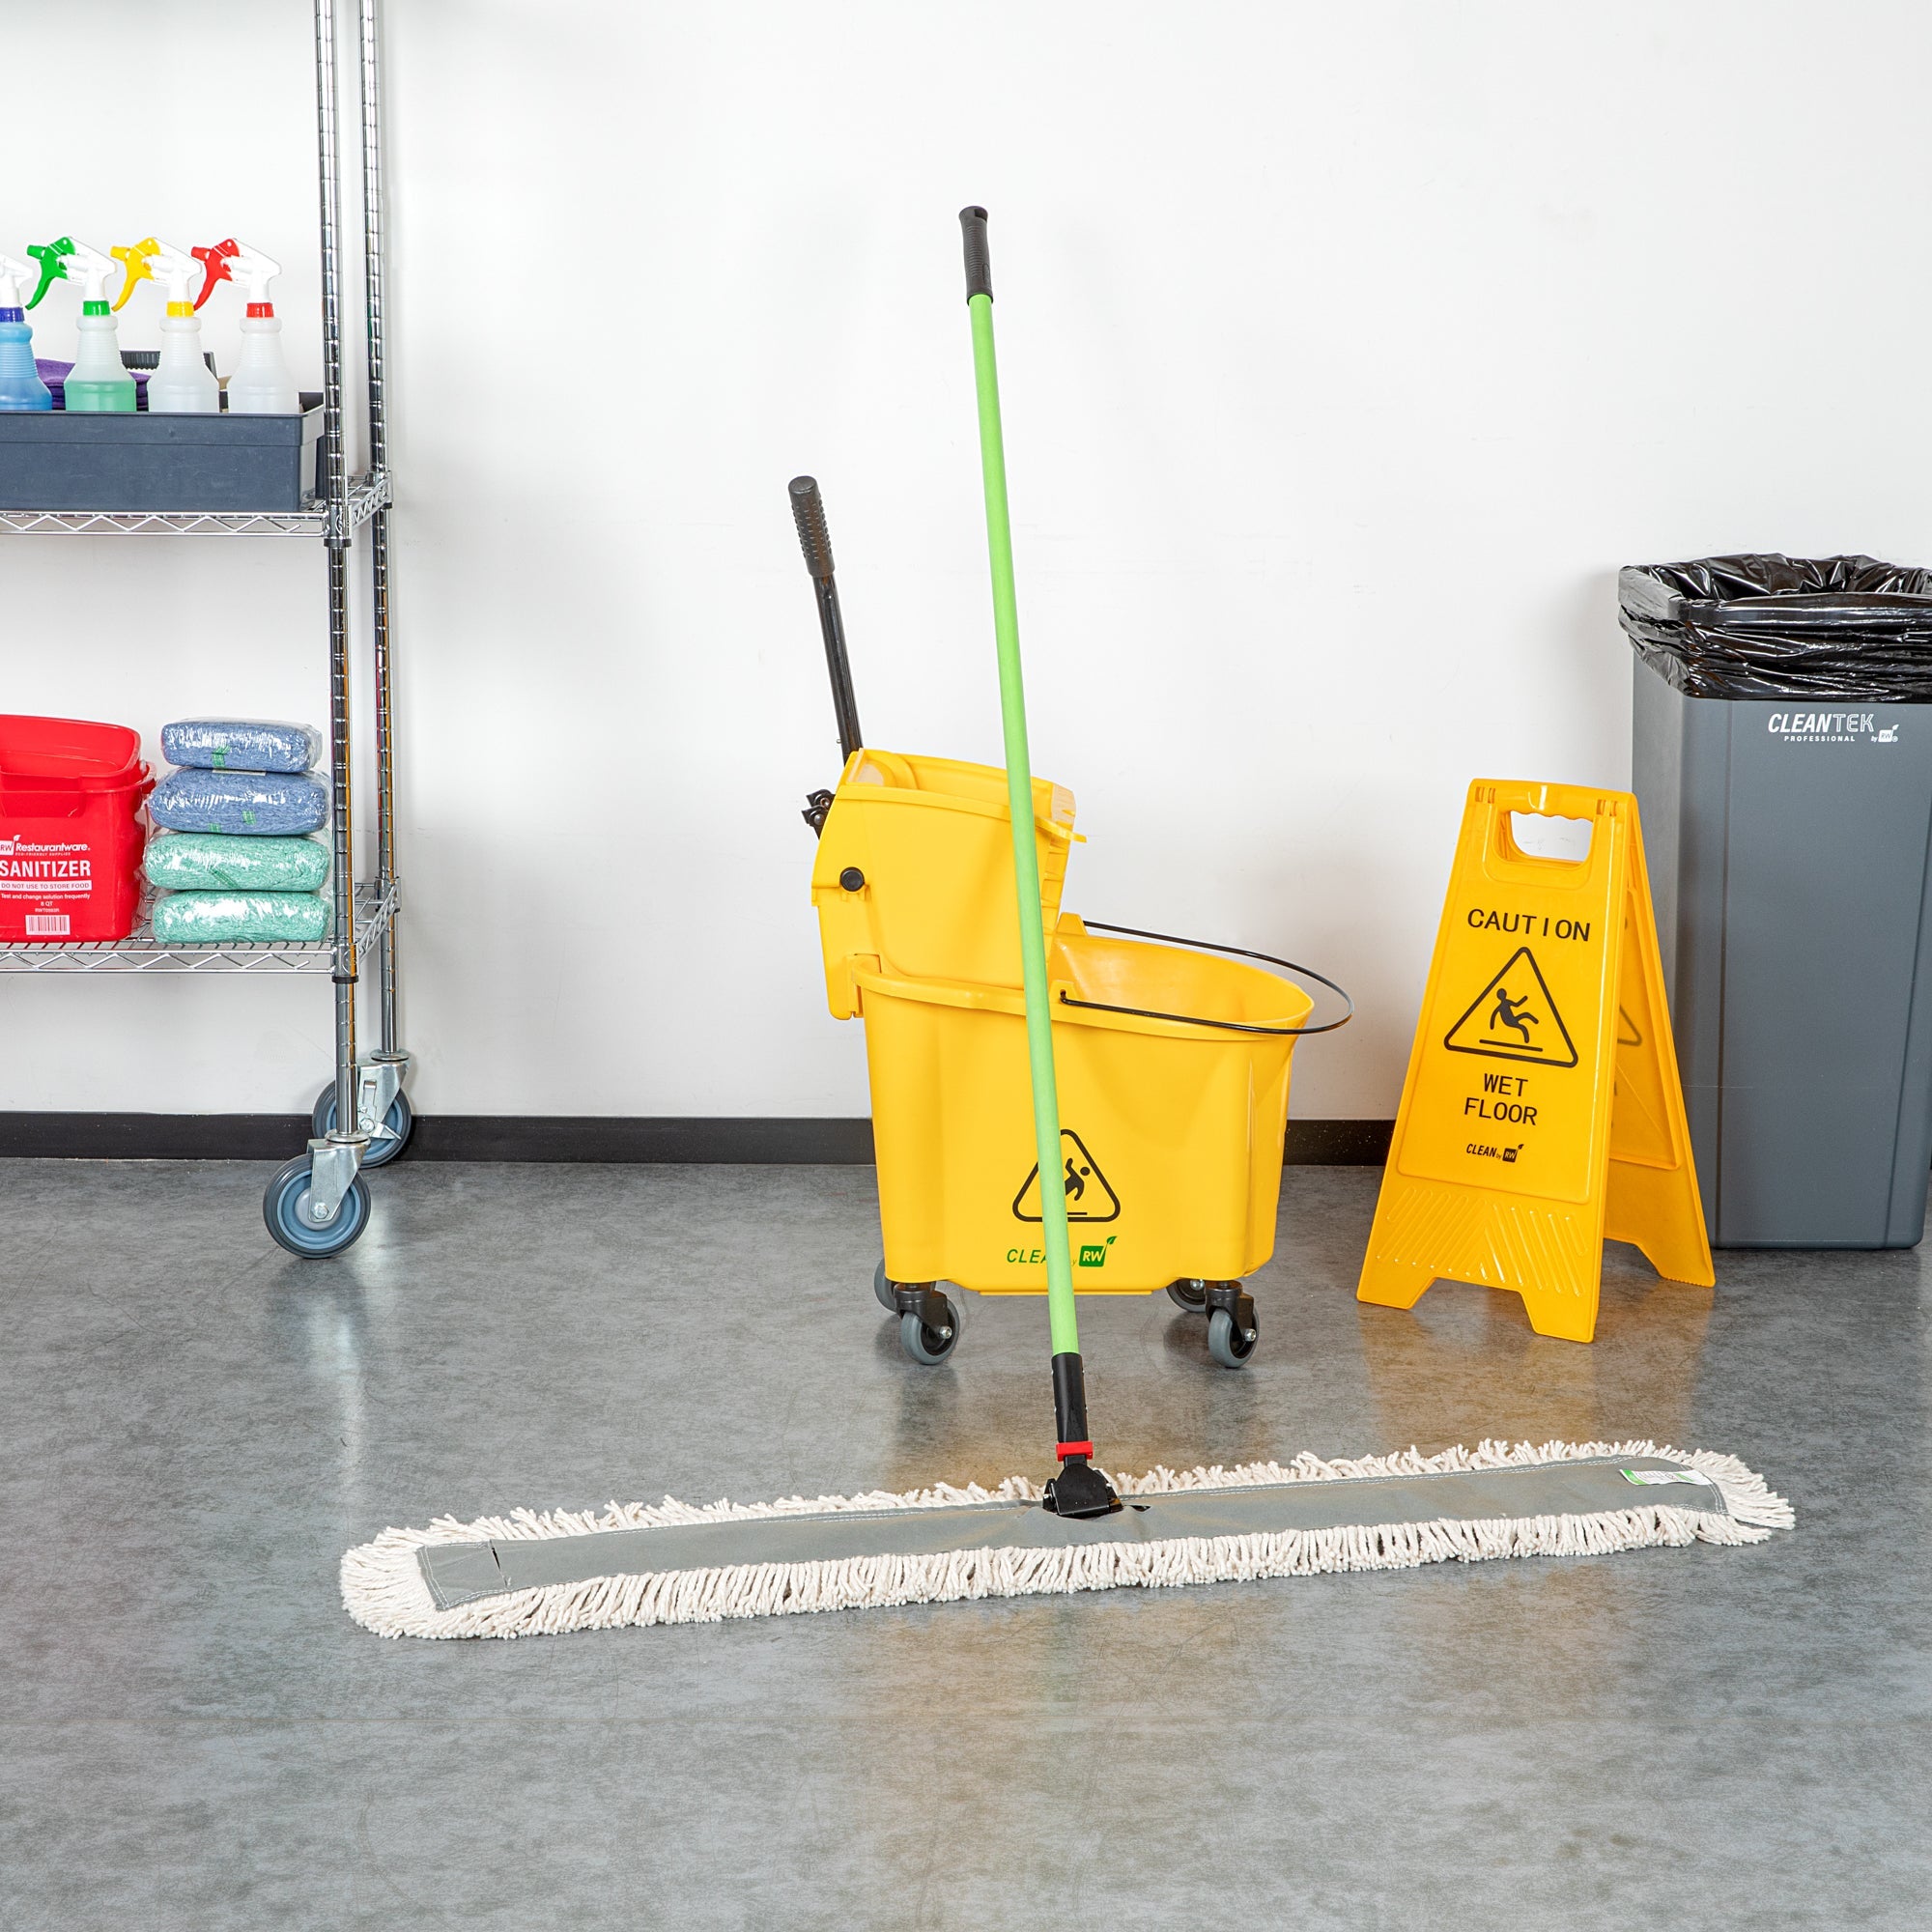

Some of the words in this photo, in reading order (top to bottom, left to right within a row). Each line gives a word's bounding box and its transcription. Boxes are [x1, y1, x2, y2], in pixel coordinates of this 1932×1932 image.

[1768, 713, 1874, 733] CLEANTEK
[0, 860, 91, 877] SANITIZER
[1466, 908, 1591, 942] CAUTION
[1483, 1072, 1528, 1096] WET
[1463, 1097, 1538, 1125] FLOOR
[1465, 1143, 1497, 1157] CLEAN
[1007, 1248, 1047, 1264] CLE
